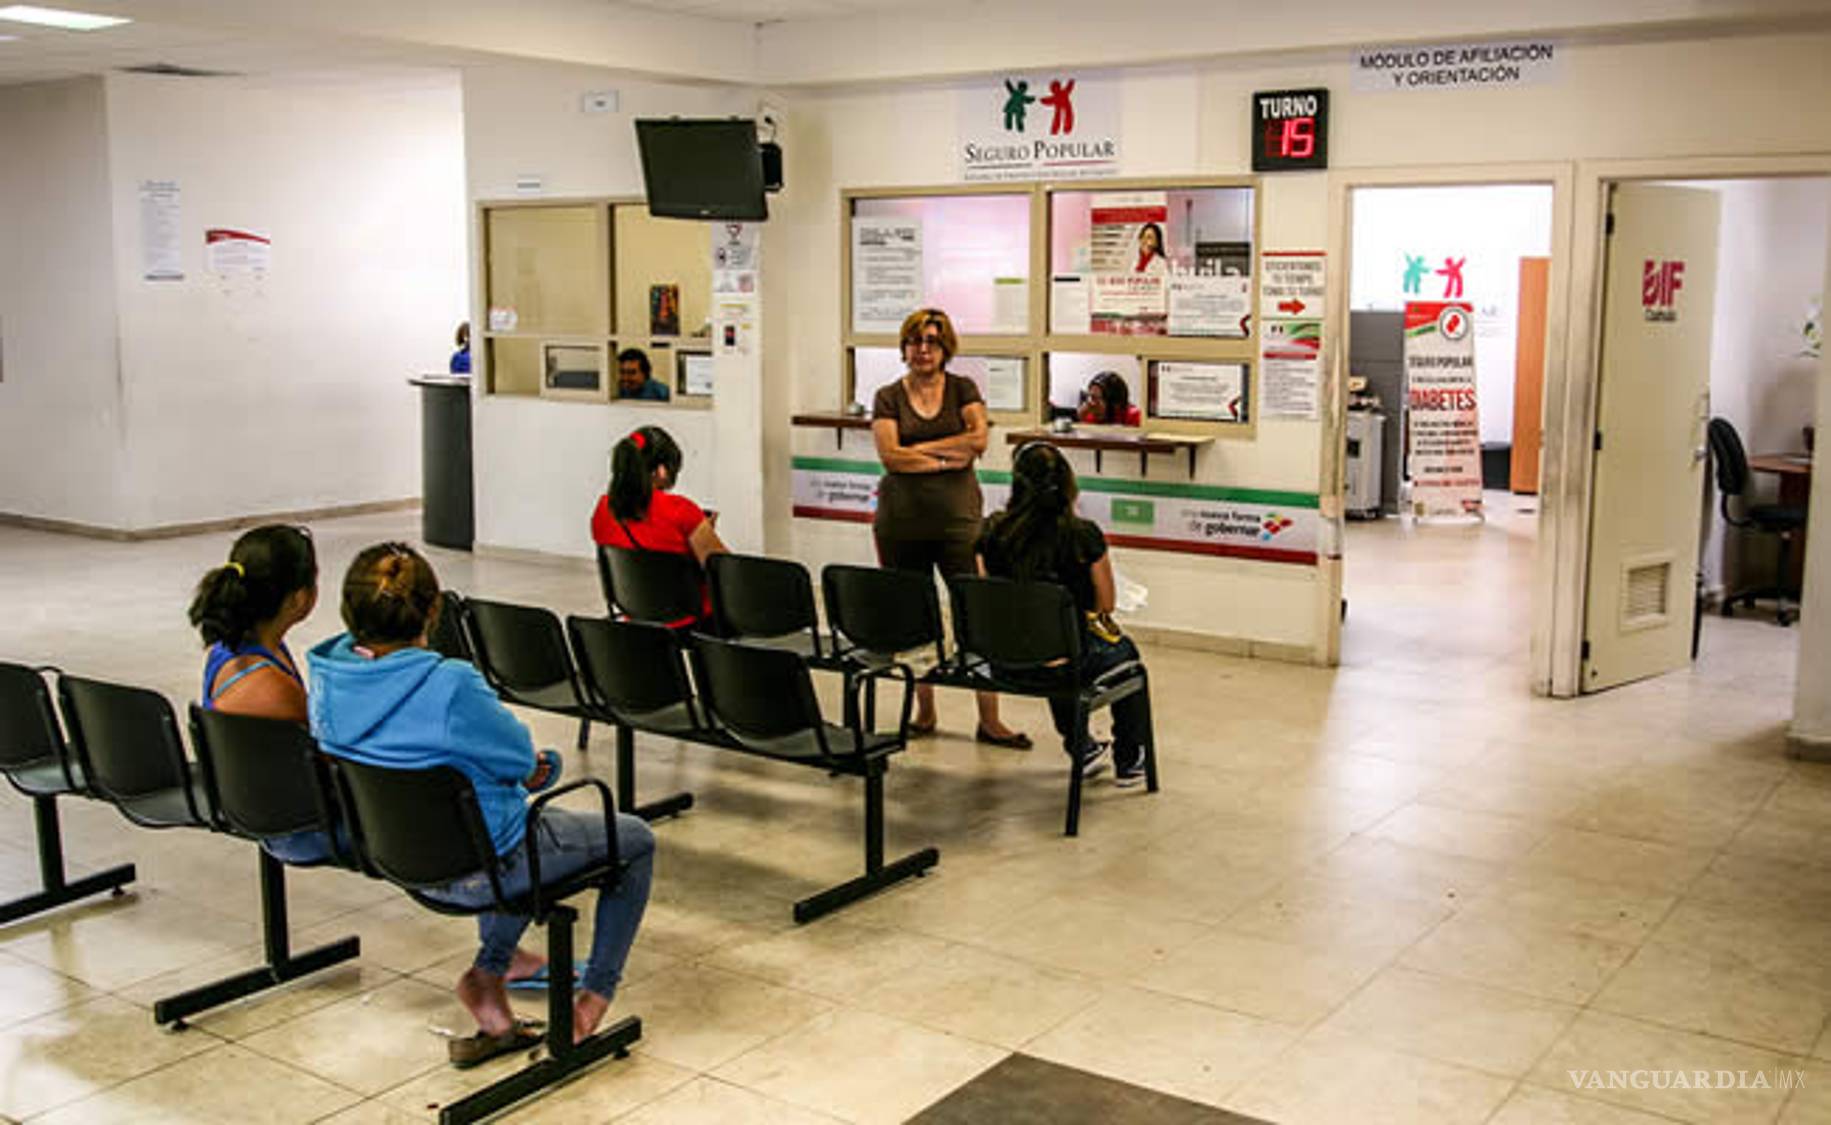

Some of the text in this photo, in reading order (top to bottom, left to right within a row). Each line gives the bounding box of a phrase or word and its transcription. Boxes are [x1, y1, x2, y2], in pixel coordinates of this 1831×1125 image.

[1361, 43, 1554, 69] MÓDULO DE AFILIACIÓN
[1393, 65, 1520, 86] Y ORIENTACIÓN
[1259, 94, 1318, 120] TURNO
[1282, 117, 1315, 158] 15
[1034, 140, 1115, 160] POPULAR
[1409, 388, 1477, 411] DIABETES
[1231, 510, 1261, 523] forma
[1204, 522, 1261, 537] gobernar
